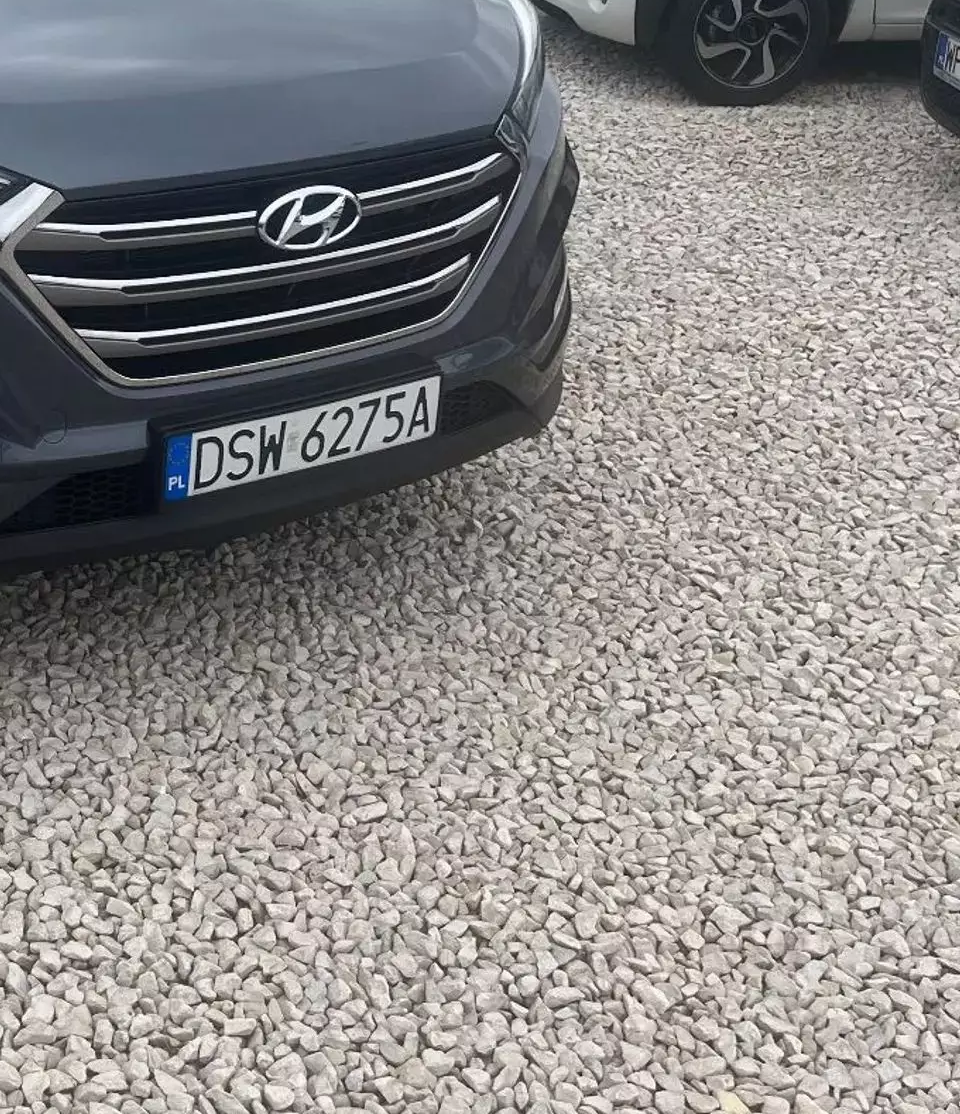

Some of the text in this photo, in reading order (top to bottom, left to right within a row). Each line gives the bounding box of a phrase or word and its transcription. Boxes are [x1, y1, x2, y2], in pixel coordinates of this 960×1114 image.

[194, 386, 429, 490] DSW 6275A
[168, 475, 185, 491] PL
